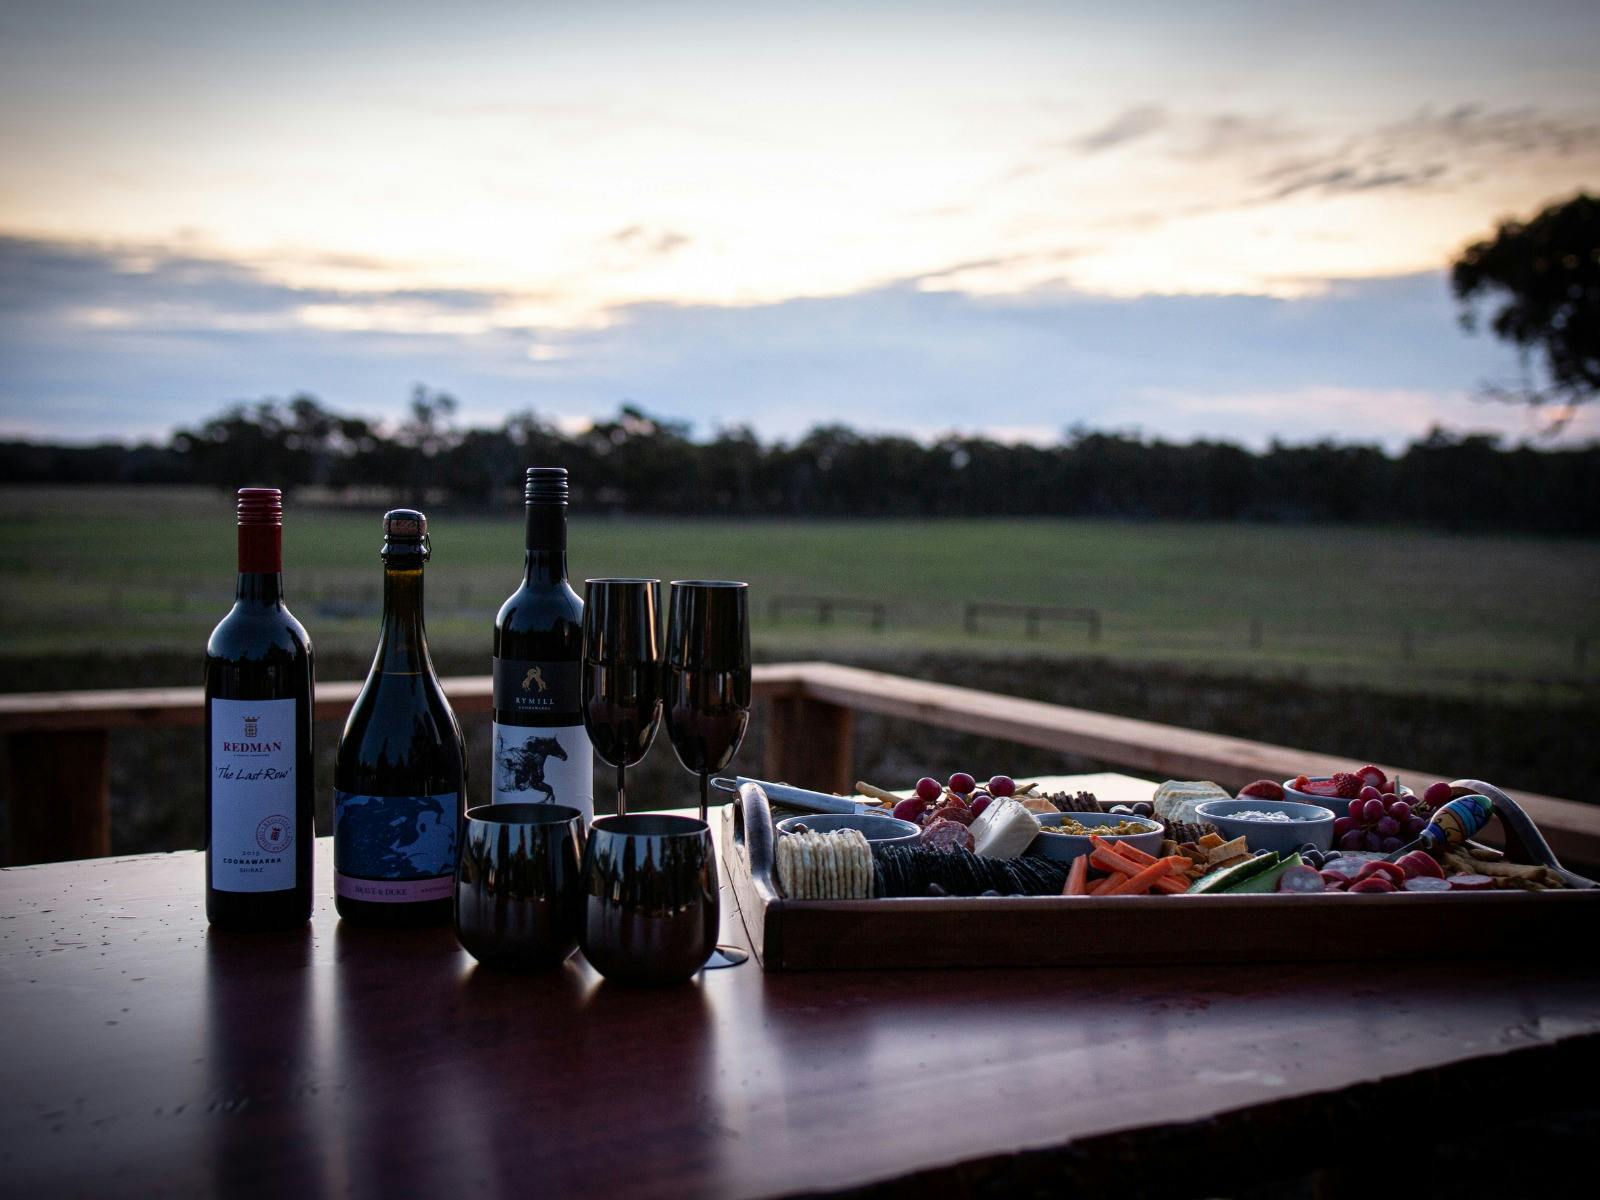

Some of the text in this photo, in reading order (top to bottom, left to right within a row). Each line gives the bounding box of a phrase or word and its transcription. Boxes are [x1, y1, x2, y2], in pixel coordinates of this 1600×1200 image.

[515, 696, 555, 705] RYMILL
[223, 742, 282, 752] REDMAN
[235, 768, 264, 780] Last
